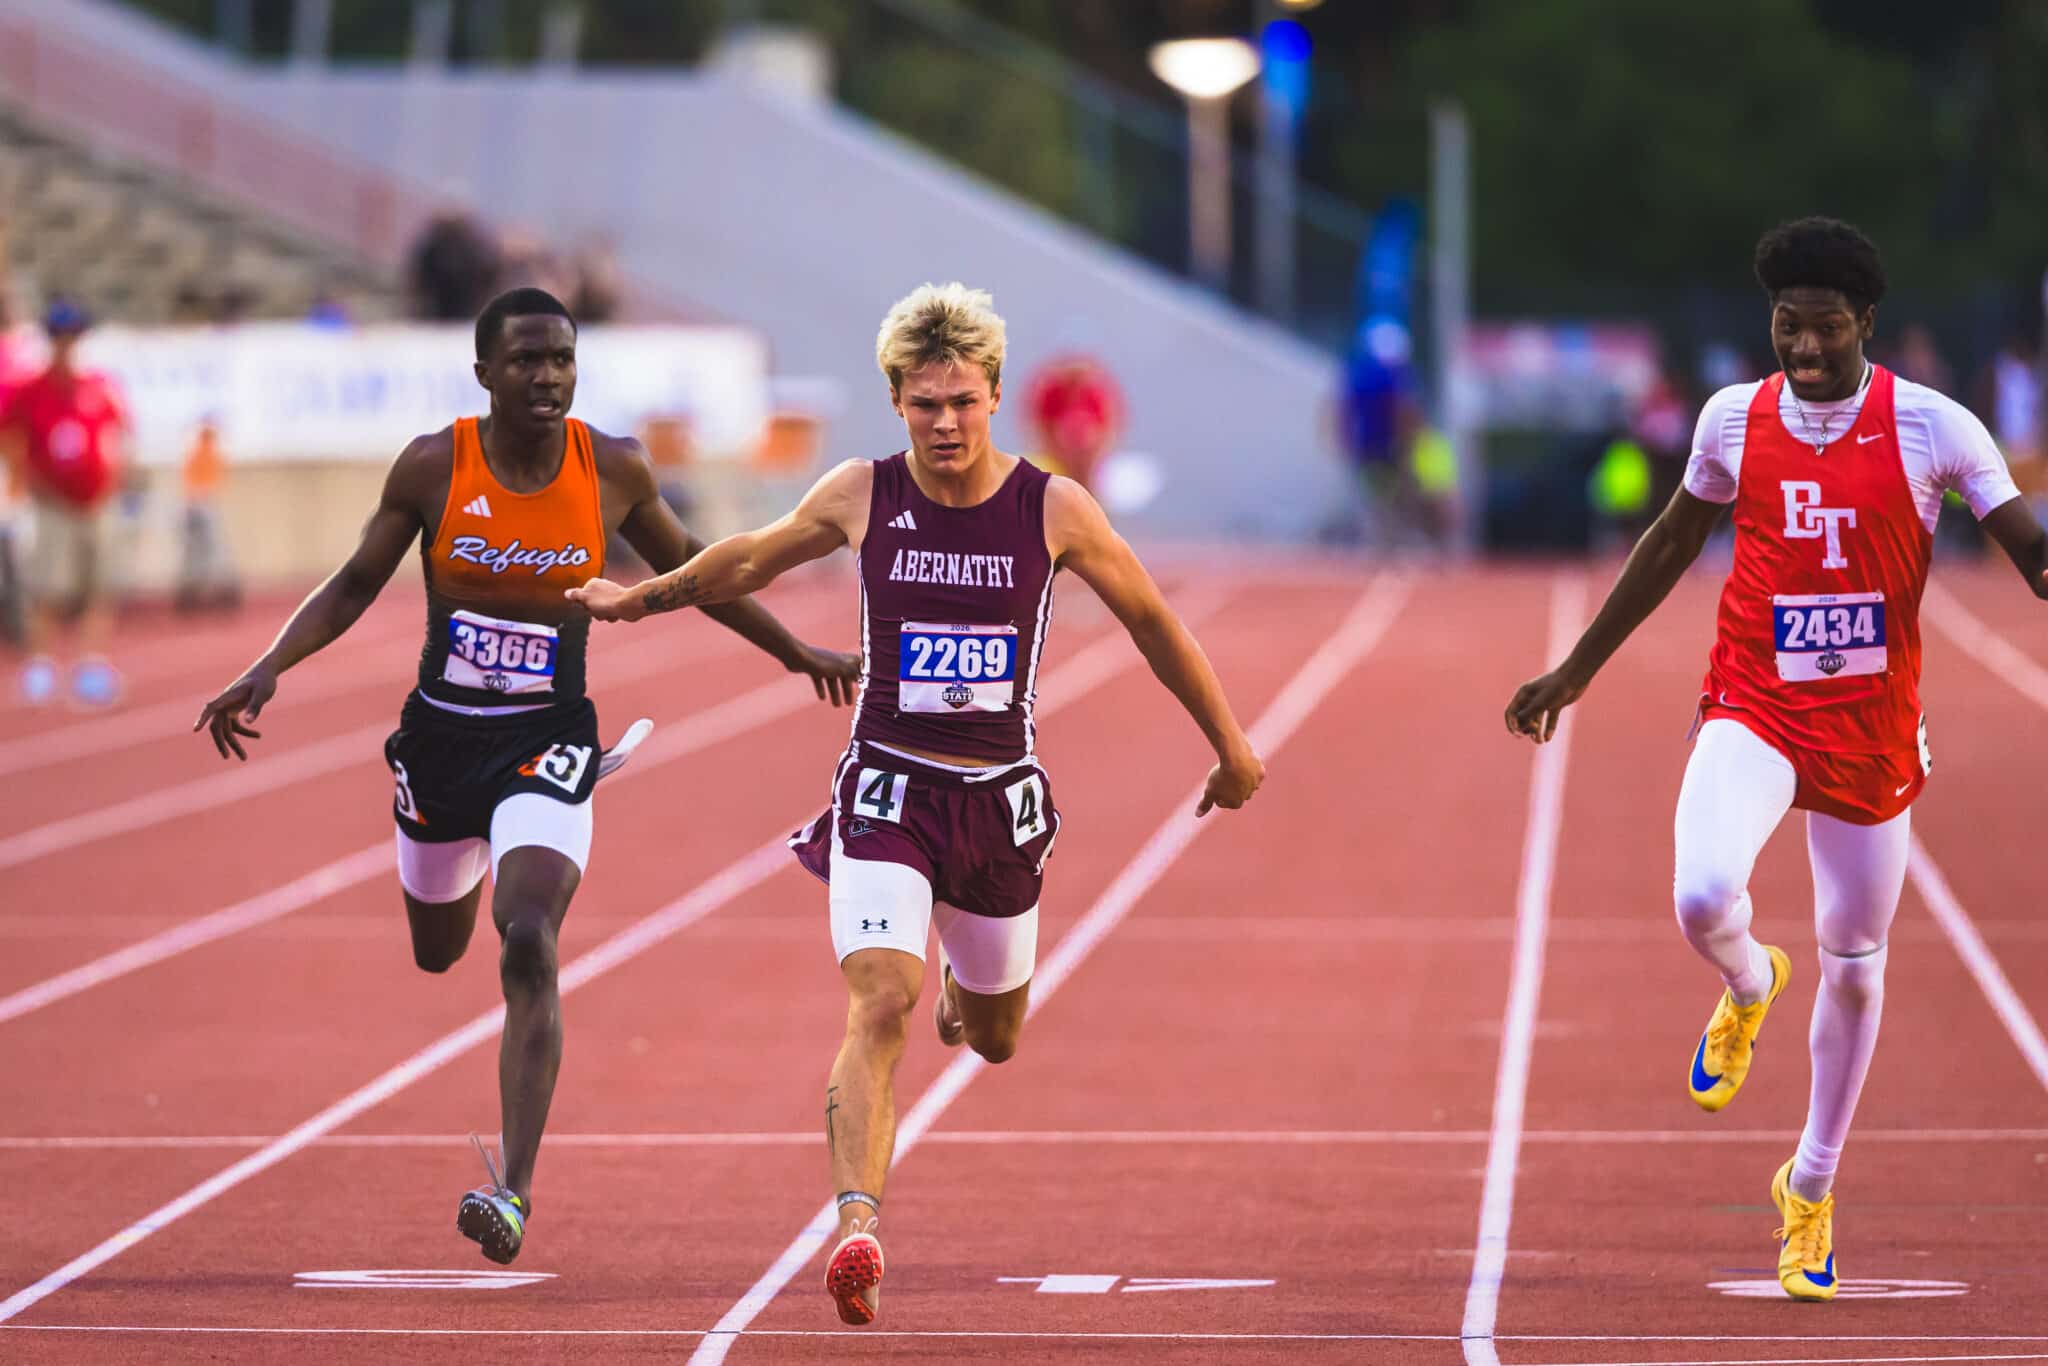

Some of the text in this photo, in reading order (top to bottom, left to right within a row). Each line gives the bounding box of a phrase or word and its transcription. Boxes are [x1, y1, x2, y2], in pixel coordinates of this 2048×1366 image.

[449, 536, 591, 575] Refugio
[888, 549, 1015, 588] ABERNATHY
[455, 625, 551, 671] 3366
[1783, 607, 1876, 648] 2434
[909, 637, 1008, 678] 2269
[943, 691, 974, 701] STATE
[546, 745, 583, 782] 5
[860, 772, 896, 818] 4
[1016, 782, 1038, 833] 4
